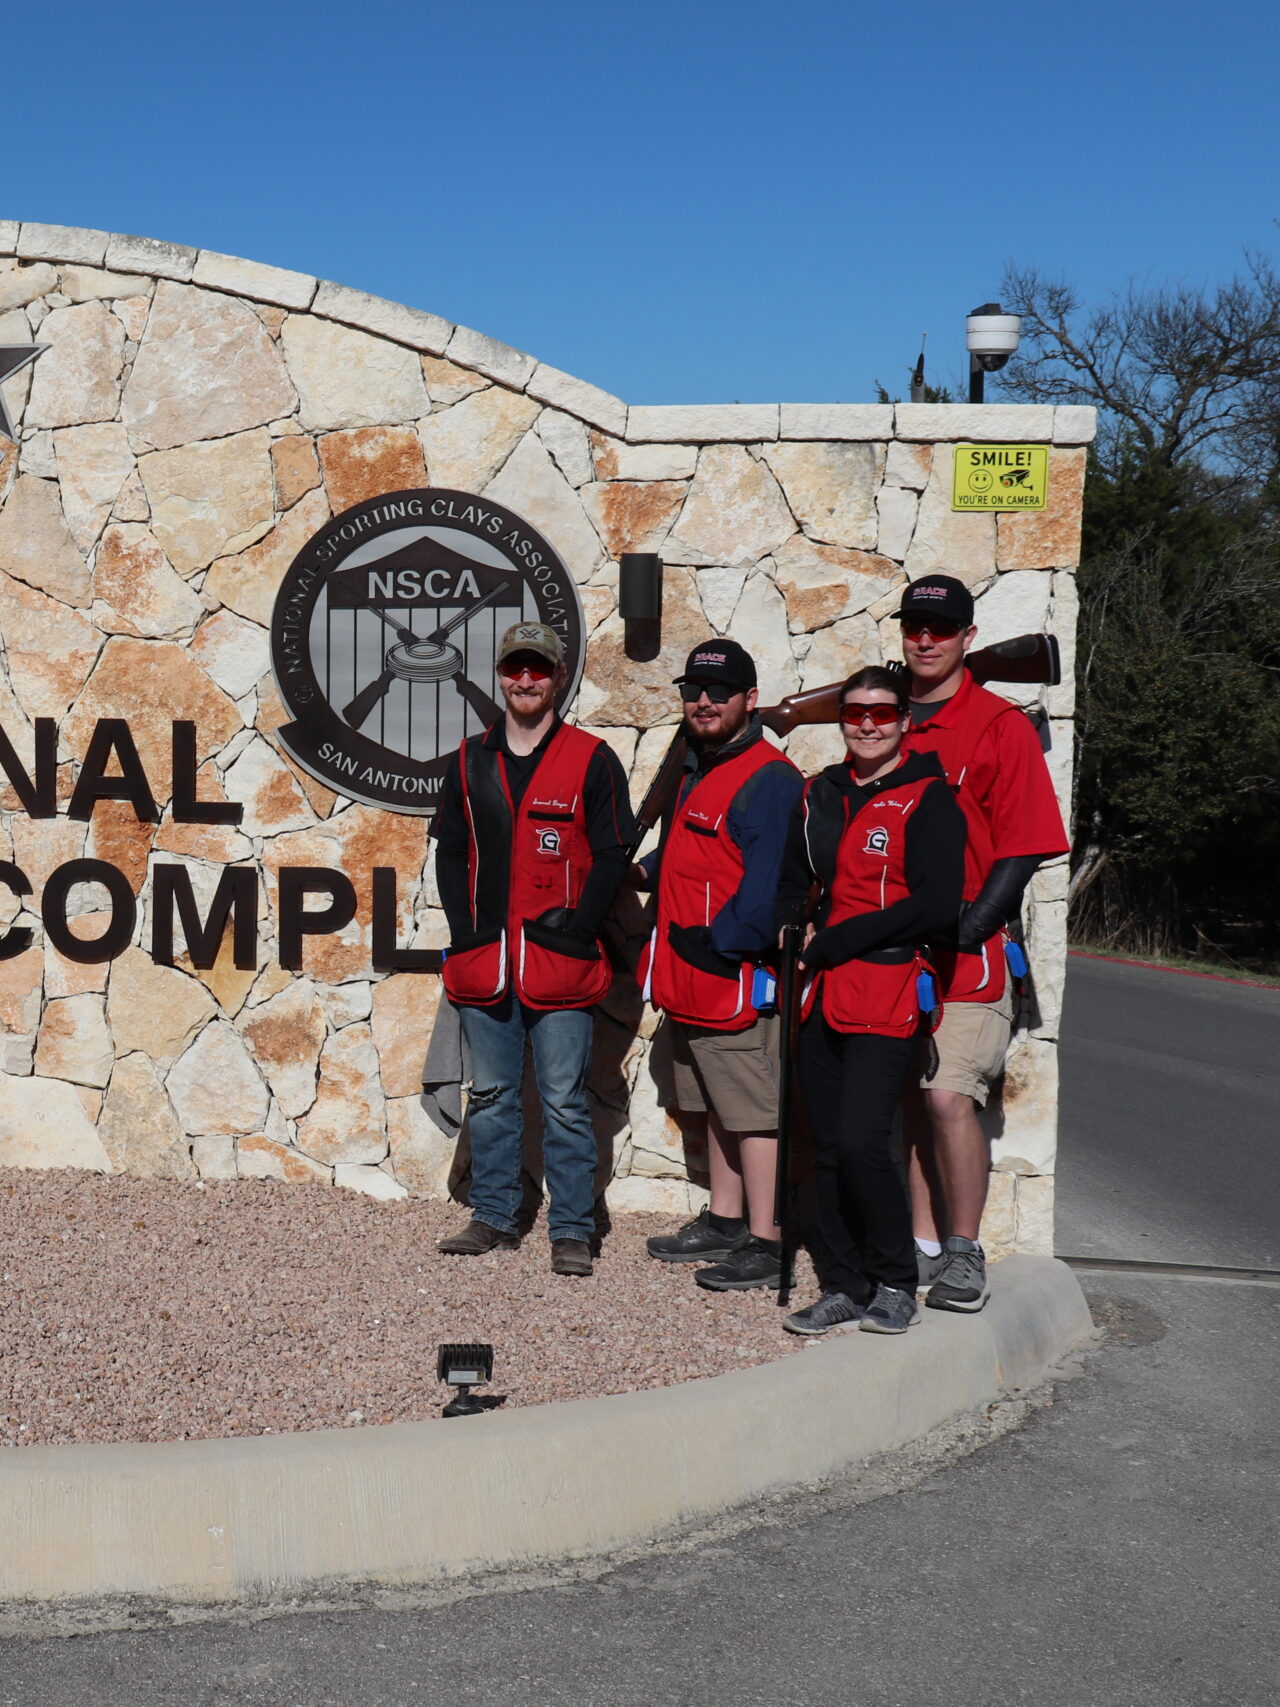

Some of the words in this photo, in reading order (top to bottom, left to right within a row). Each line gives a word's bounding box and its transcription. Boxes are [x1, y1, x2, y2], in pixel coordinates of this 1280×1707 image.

[970, 451, 1032, 466] SMILE!
[958, 495, 988, 504] YOU'RE
[991, 495, 1004, 504] ON
[1006, 495, 1040, 505] CAMERA
[283, 568, 317, 674] NATIONAL
[316, 499, 424, 561] SPORTING
[431, 499, 503, 535] CLAYS
[502, 530, 569, 654] ASSOCIATI
[368, 570, 481, 599] NSCA
[317, 743, 359, 776] SAN
